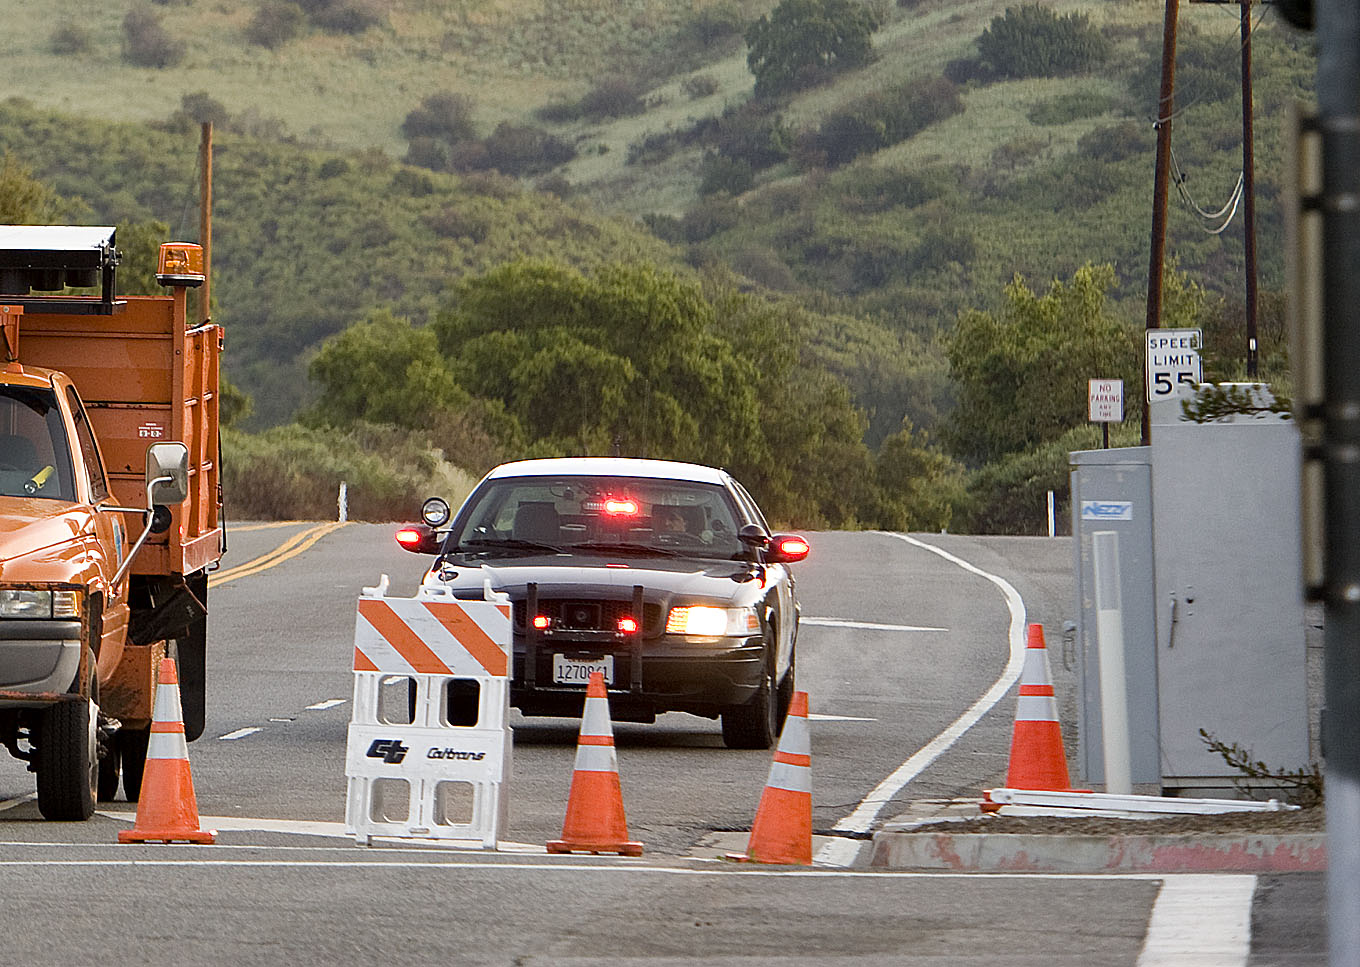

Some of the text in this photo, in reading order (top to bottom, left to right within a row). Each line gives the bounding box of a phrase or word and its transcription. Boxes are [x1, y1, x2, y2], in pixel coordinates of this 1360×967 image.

[1154, 354, 1193, 366] LIMIT
[1099, 384, 1112, 393] NO
[1090, 393, 1120, 403] PARKING
[426, 747, 486, 761] Caltrans
